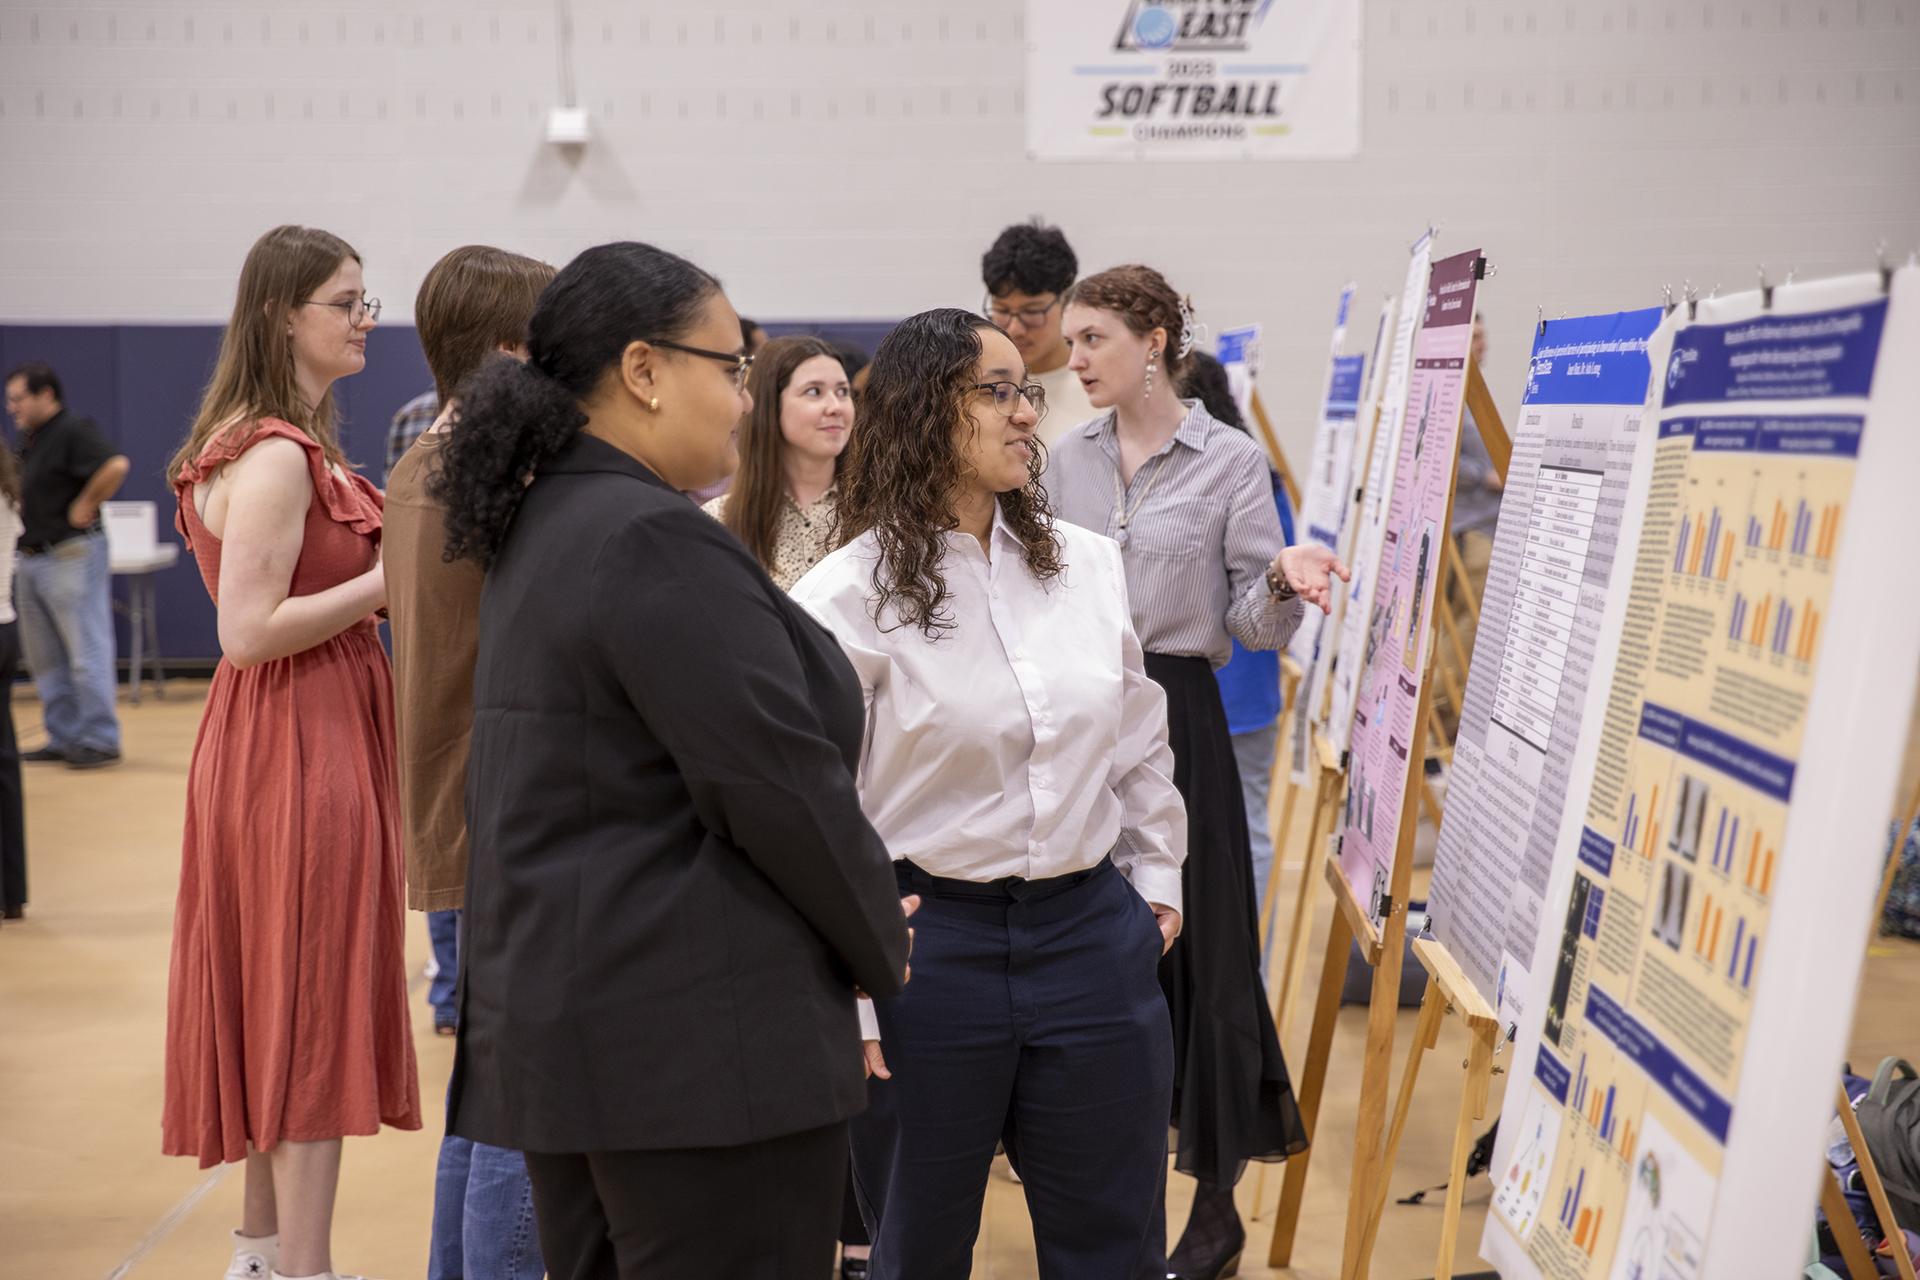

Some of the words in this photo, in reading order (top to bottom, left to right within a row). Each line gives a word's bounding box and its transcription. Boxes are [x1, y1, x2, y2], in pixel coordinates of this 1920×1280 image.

[1176, 10, 1250, 39] EAST
[1098, 82, 1282, 118] SOFTBALL
[1134, 122, 1246, 140] CHAMPIONS
